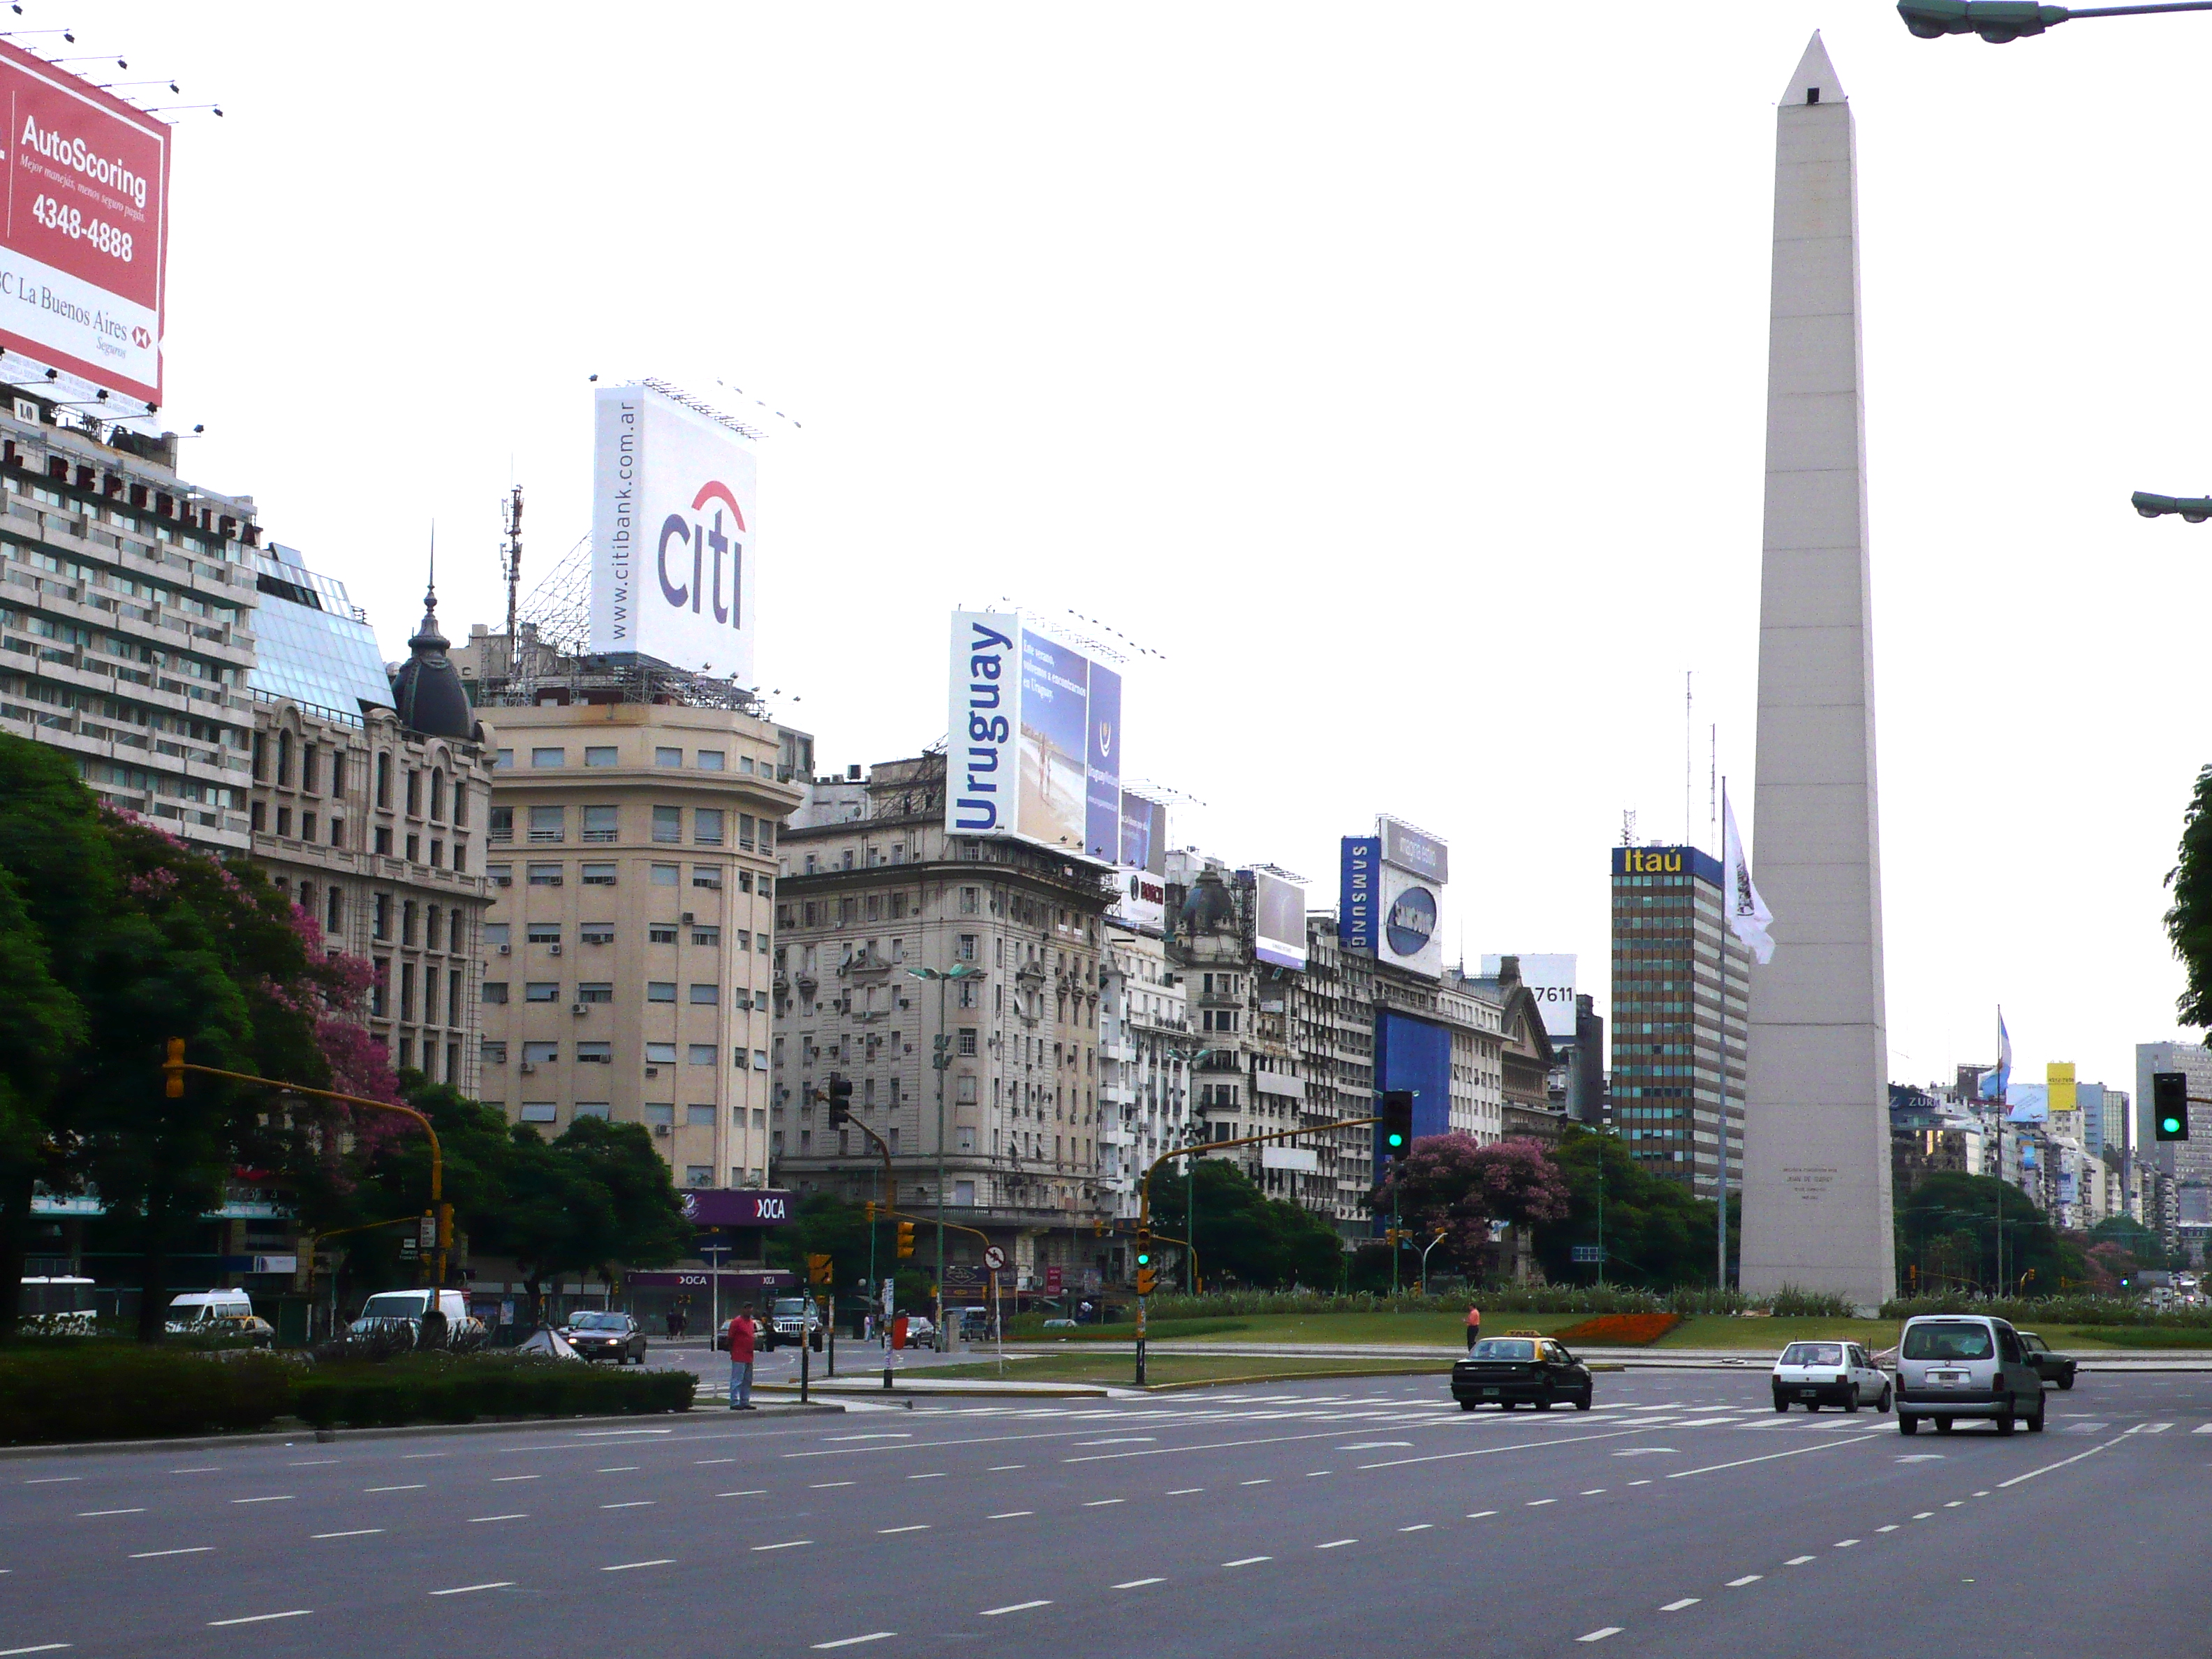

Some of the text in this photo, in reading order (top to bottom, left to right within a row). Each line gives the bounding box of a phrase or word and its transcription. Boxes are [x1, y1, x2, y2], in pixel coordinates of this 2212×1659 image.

[20, 153, 43, 175] Mejor
[78, 183, 100, 201] menos
[102, 194, 124, 210] seguro
[21, 115, 147, 209] AutoScoring
[32, 193, 133, 263] 4348-4888
[19, 276, 36, 304] La
[40, 286, 91, 327] Buenos
[93, 309, 128, 341] Aires
[96, 337, 127, 359] Seguros
[49, 455, 257, 545] REPUBLICA
[612, 401, 634, 640] www.citibank.com.ar
[657, 509, 742, 631] citi
[956, 621, 1013, 830] Uruguay
[1624, 848, 1681, 872] Itaú
[1351, 846, 1368, 948] SAMSUNG
[1535, 987, 1572, 1002] 7611
[763, 1197, 786, 1219] OCA
[685, 1276, 707, 1285] OCA
